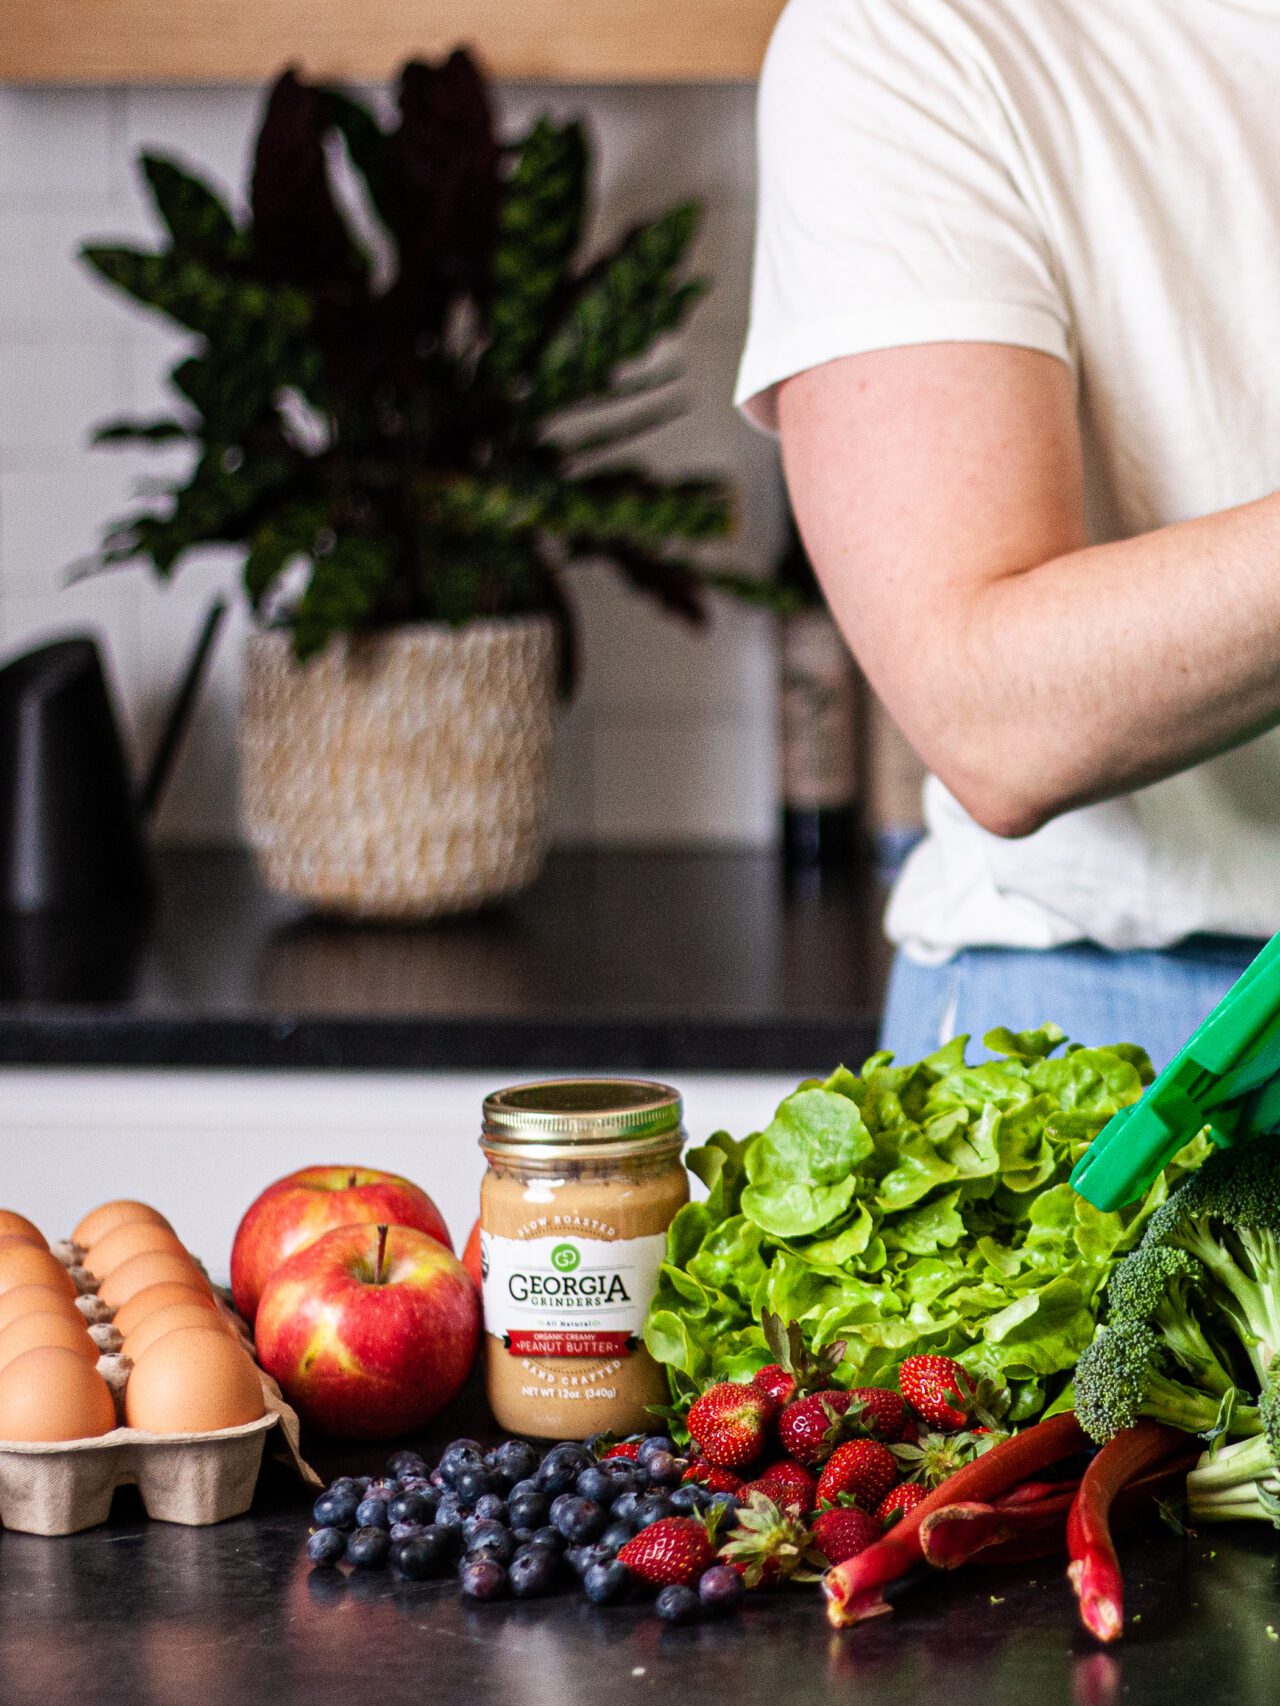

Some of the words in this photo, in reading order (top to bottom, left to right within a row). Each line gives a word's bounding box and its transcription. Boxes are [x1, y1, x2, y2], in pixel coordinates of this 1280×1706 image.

[517, 1217, 547, 1236] SLOW
[554, 1216, 615, 1236] ROASTED
[509, 1274, 631, 1303] GEORGIA
[531, 1297, 601, 1307] GRINDERS
[533, 1333, 565, 1341] ORGANIC
[521, 1341, 562, 1353] PEANUT
[566, 1341, 614, 1353] BUTTER
[522, 1359, 555, 1383] HAND
[561, 1360, 621, 1385] CRAFTED
[522, 1386, 538, 1396] NET
[539, 1387, 555, 1397] WT
[585, 1387, 617, 1400] (340g)
